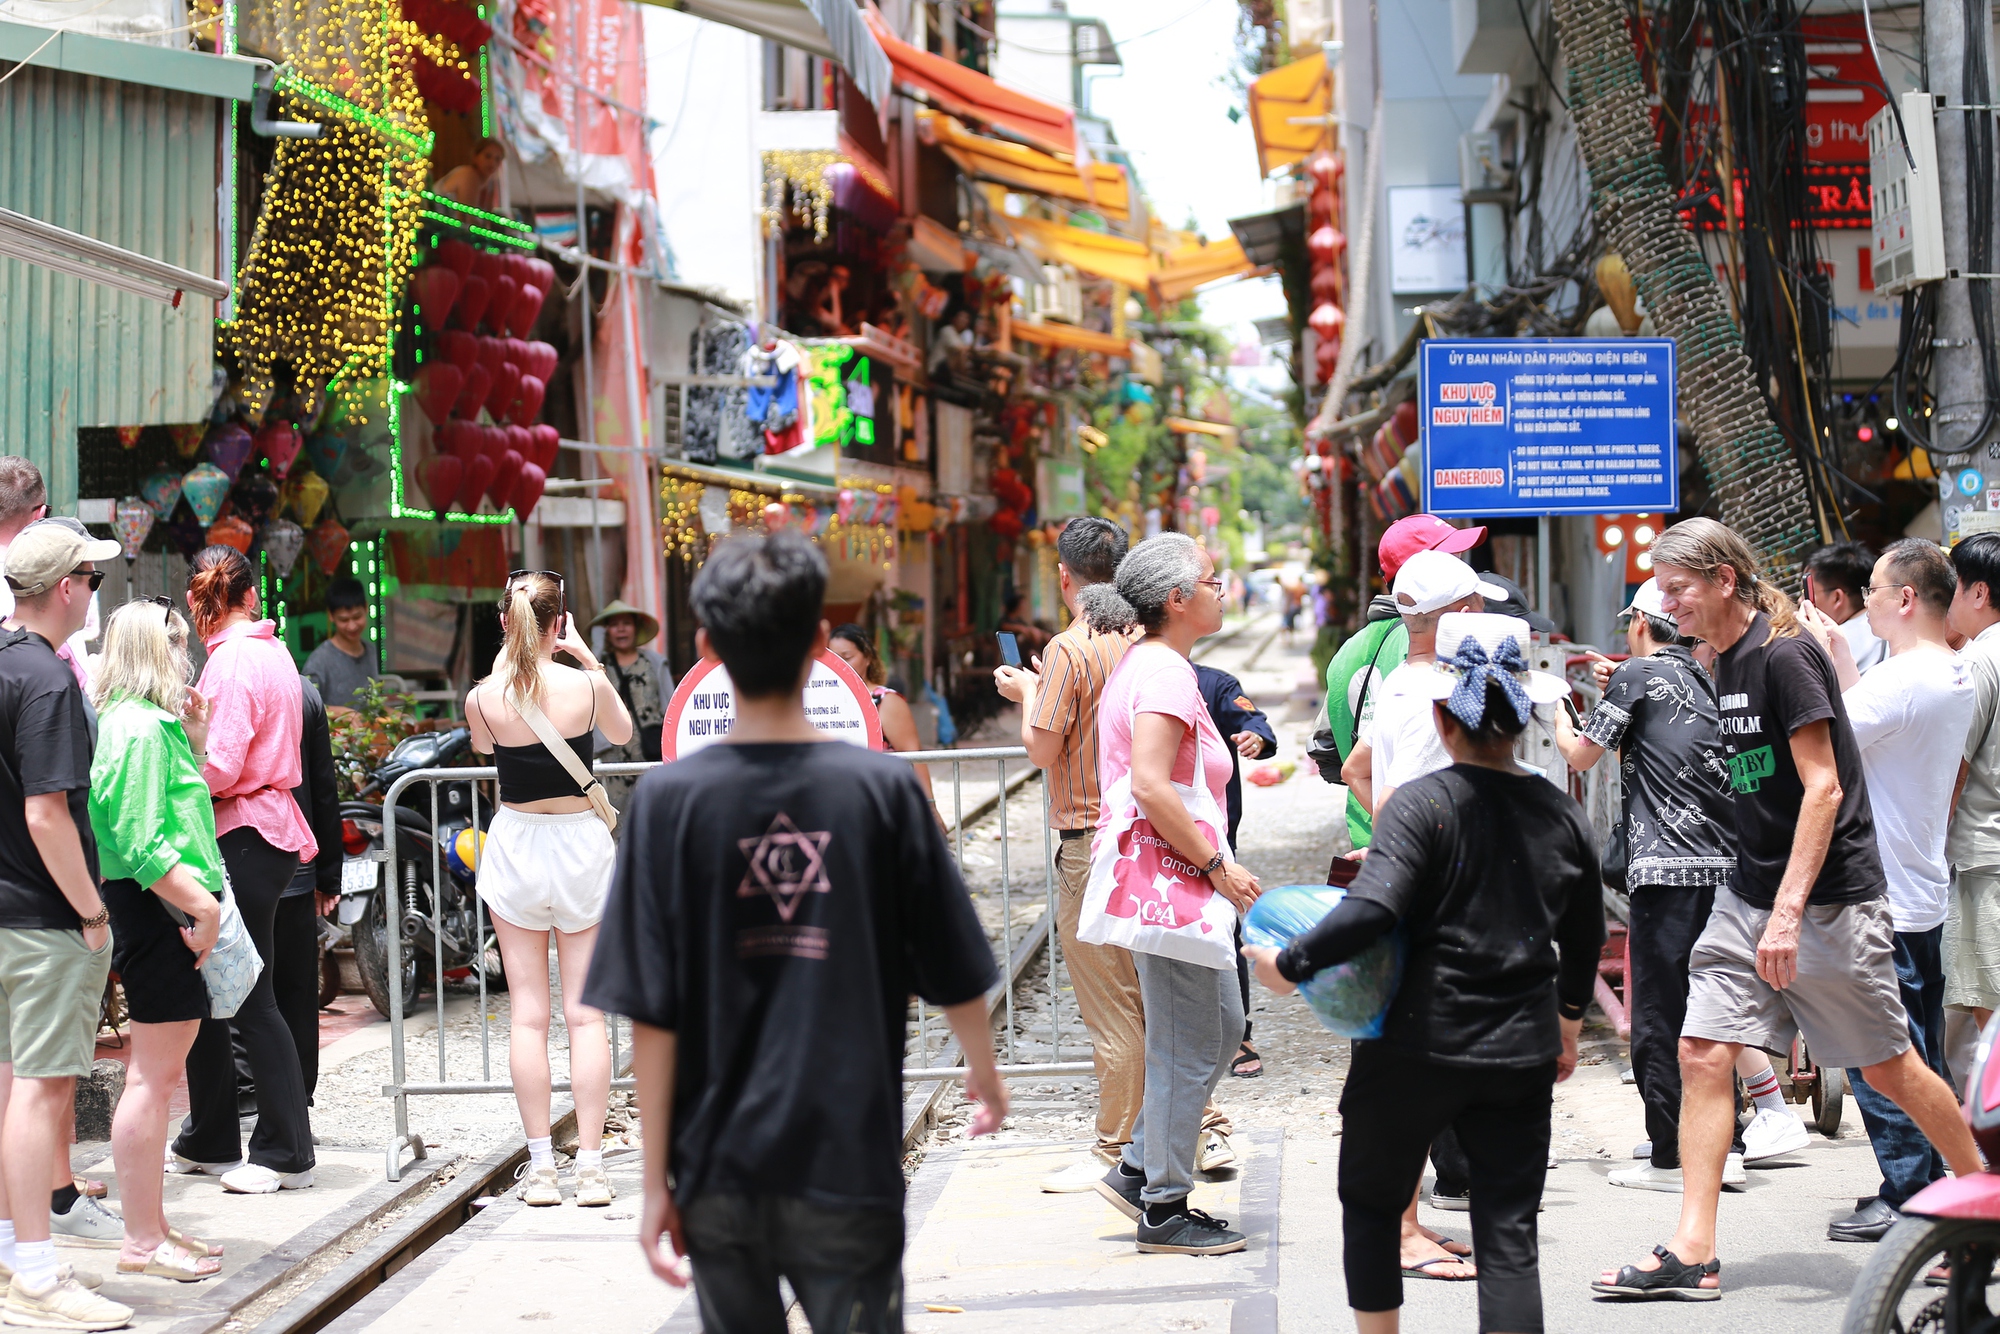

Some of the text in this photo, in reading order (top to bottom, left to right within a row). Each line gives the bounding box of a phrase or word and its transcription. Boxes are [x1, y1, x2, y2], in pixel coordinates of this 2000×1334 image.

[1449, 350, 1647, 367] ỦY BAN NHÂN DÂN PHƯỜNG ĐIỆN BIÊN
[1515, 373, 1535, 385] KHÔNG
[1593, 374, 1609, 386] QUAY
[1609, 374, 1626, 386] PHIM,
[1627, 374, 1643, 387] CHỤP
[1441, 382, 1495, 404] KHU VỰC
[1515, 390, 1535, 402] KHÔNG
[1434, 402, 1503, 424] NGUY HIỂM
[1515, 407, 1535, 419] KHÔNG
[1598, 406, 1614, 418] HÀNG
[1615, 407, 1634, 418] TRONG
[1517, 444, 1661, 456] DO NOT GATHER A CROWD, TAKE PHOTOS, VIDEOS.
[1517, 459, 1661, 471] DO NOT WALK, STAND, SIT ON RAILROAD TRACKS.
[1435, 468, 1503, 487] DANGEROUS
[1517, 474, 1663, 487] DO NOT DISPLAY CHAIRS, TABLES AND PEDDLE ON
[1518, 486, 1610, 498] AND ALONG RAILROAD TRACKS.
[811, 680, 824, 688] QUAY
[825, 679, 839, 687] PHIM,
[693, 691, 729, 712] KHU VỰC
[689, 719, 711, 735] NGUY
[830, 720, 845, 729] TRONG
[846, 719, 859, 728] LÒNG
[1142, 900, 1177, 926] C&A
